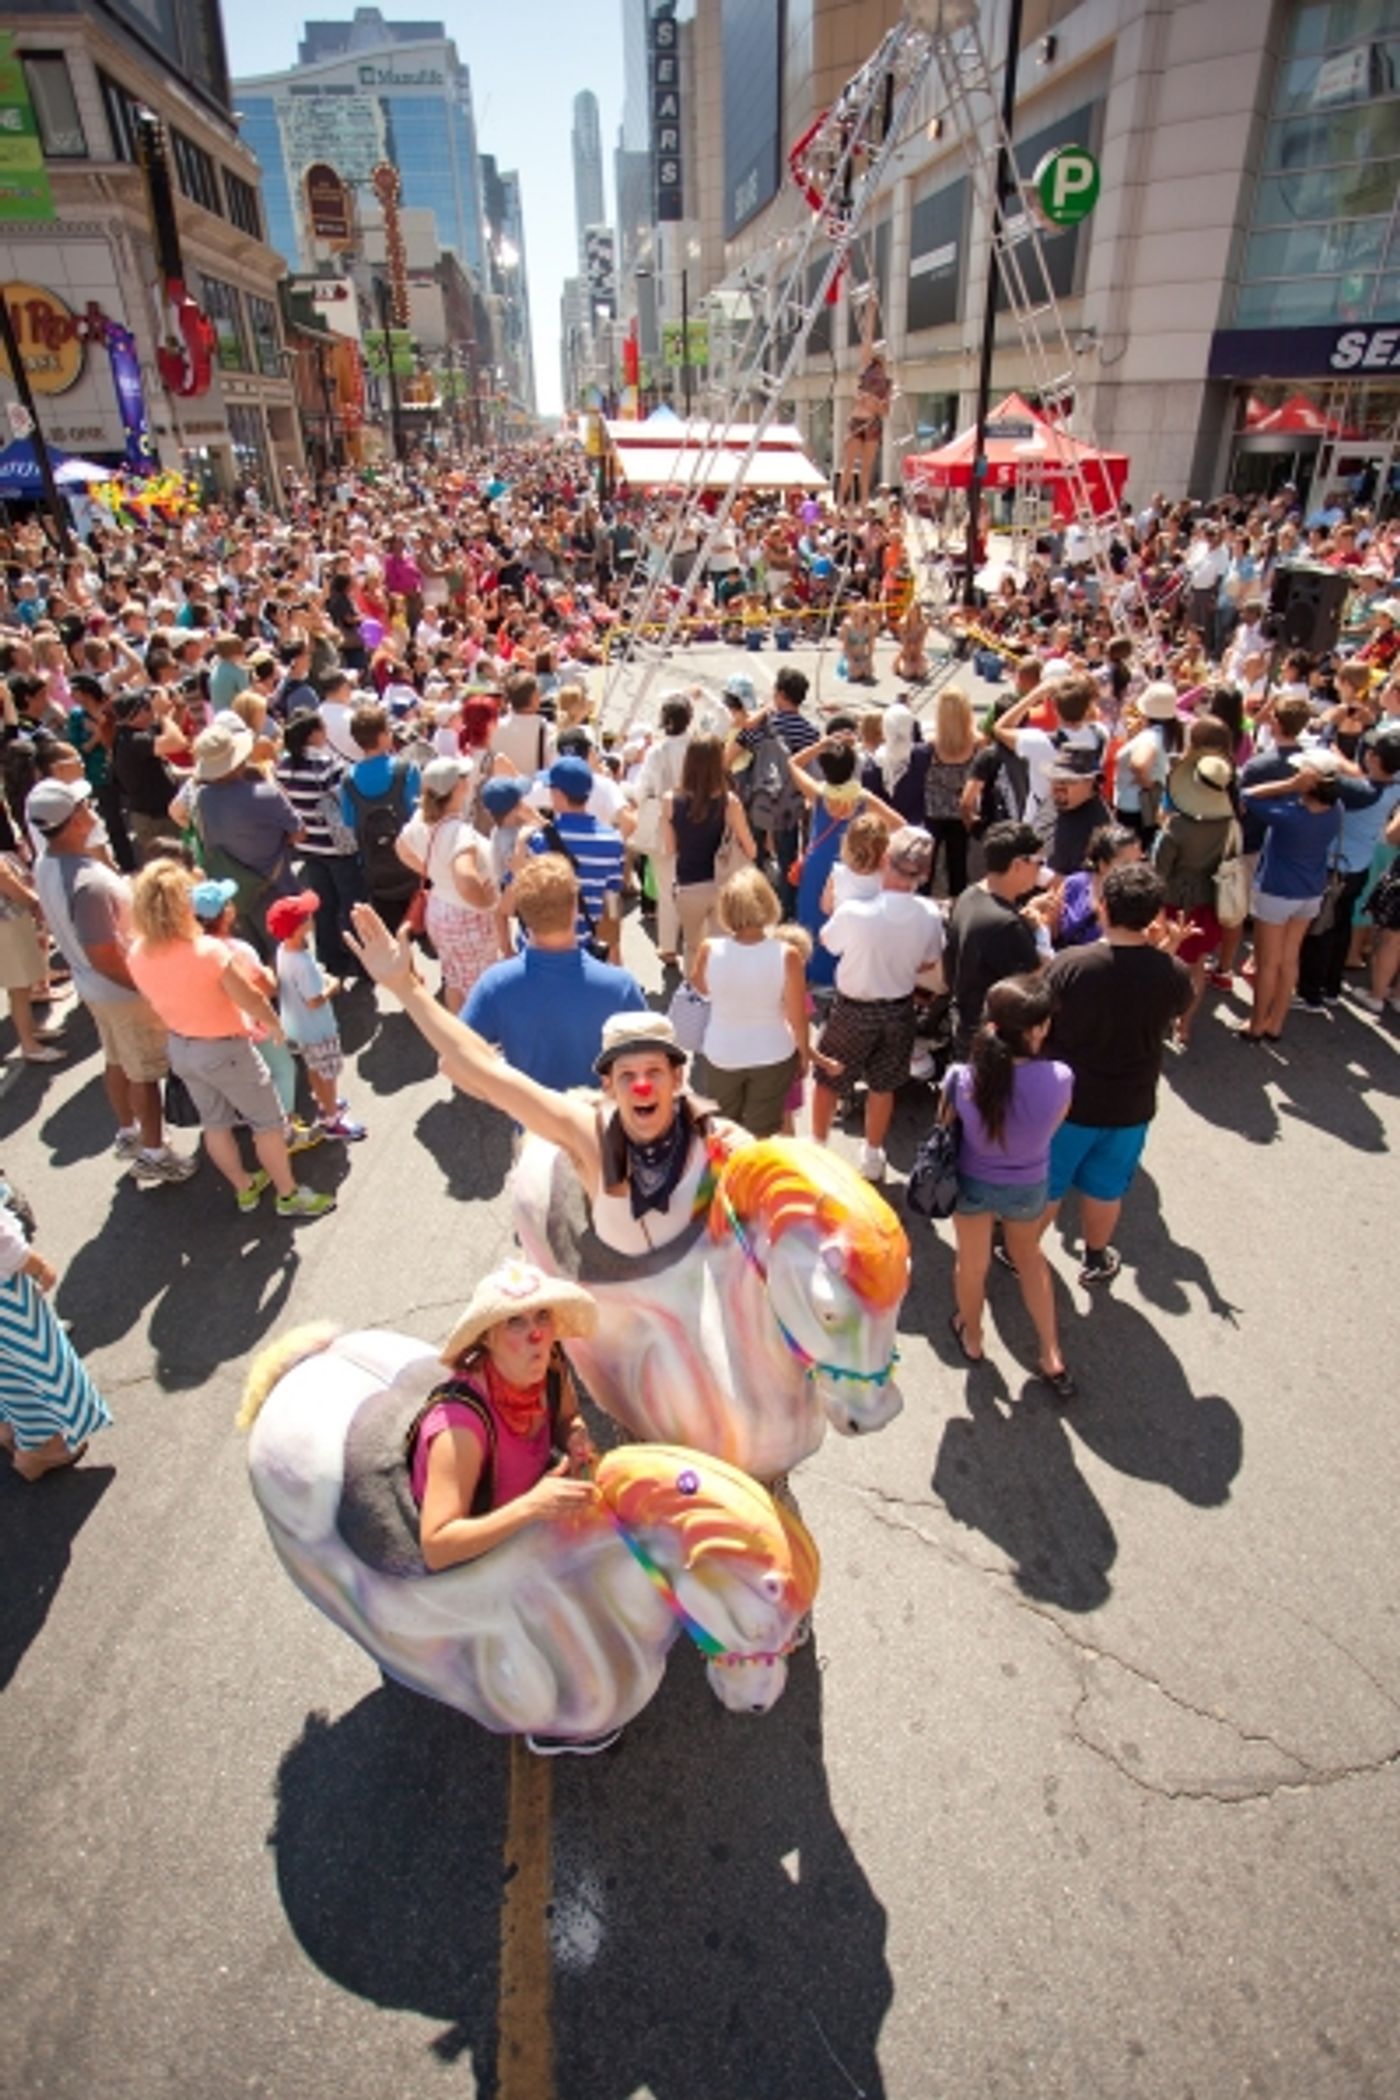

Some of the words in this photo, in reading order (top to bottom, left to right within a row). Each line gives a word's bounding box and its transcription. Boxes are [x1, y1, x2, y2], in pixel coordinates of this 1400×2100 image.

[656, 21, 677, 184] SEARS
[1053, 157, 1094, 207] P
[1330, 329, 1400, 369] SE
